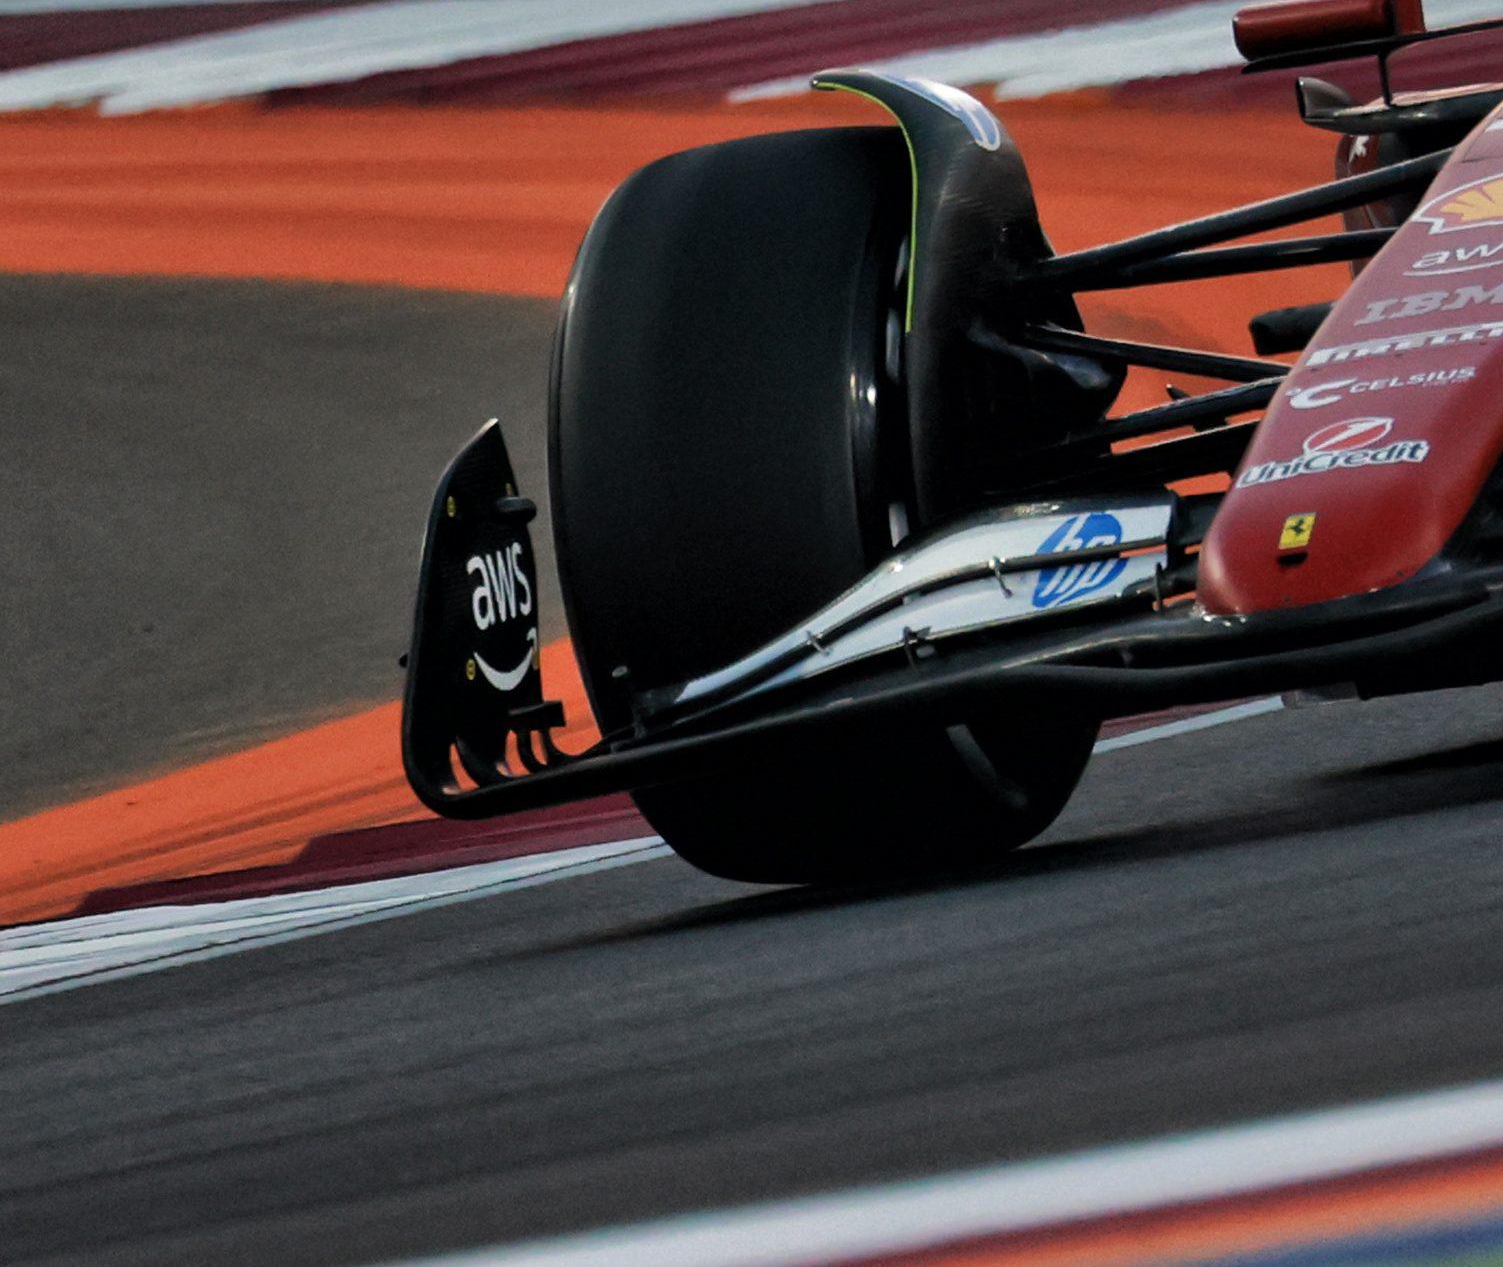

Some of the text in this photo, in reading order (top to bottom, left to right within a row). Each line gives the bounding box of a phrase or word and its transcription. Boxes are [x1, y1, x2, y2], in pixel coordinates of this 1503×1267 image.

[1349, 366, 1477, 394] CELSIUS
[1238, 440, 1430, 488] UniCredit
[466, 541, 532, 631] aws
[1039, 514, 1118, 607] hp
